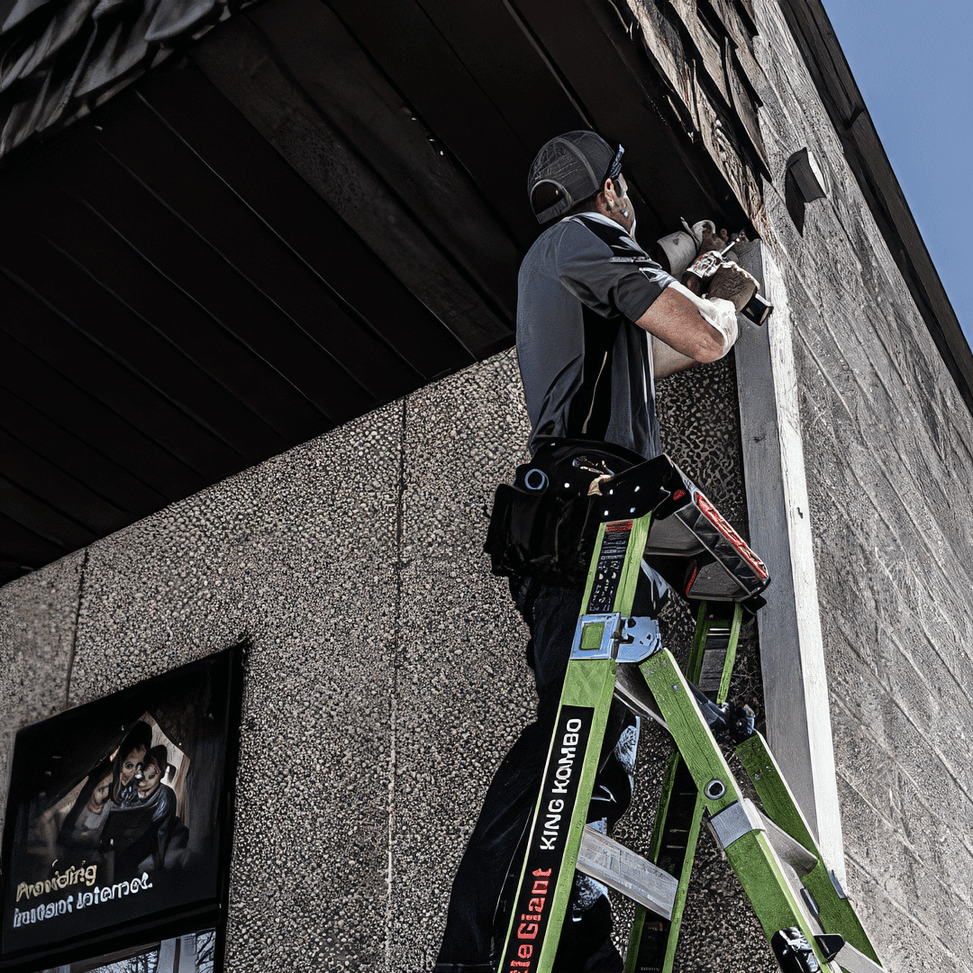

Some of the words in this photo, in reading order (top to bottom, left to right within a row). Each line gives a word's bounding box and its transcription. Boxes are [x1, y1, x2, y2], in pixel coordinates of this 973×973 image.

[551, 717, 582, 794] KOMBO
[539, 798, 565, 851] KING
[517, 867, 552, 940] Giant
